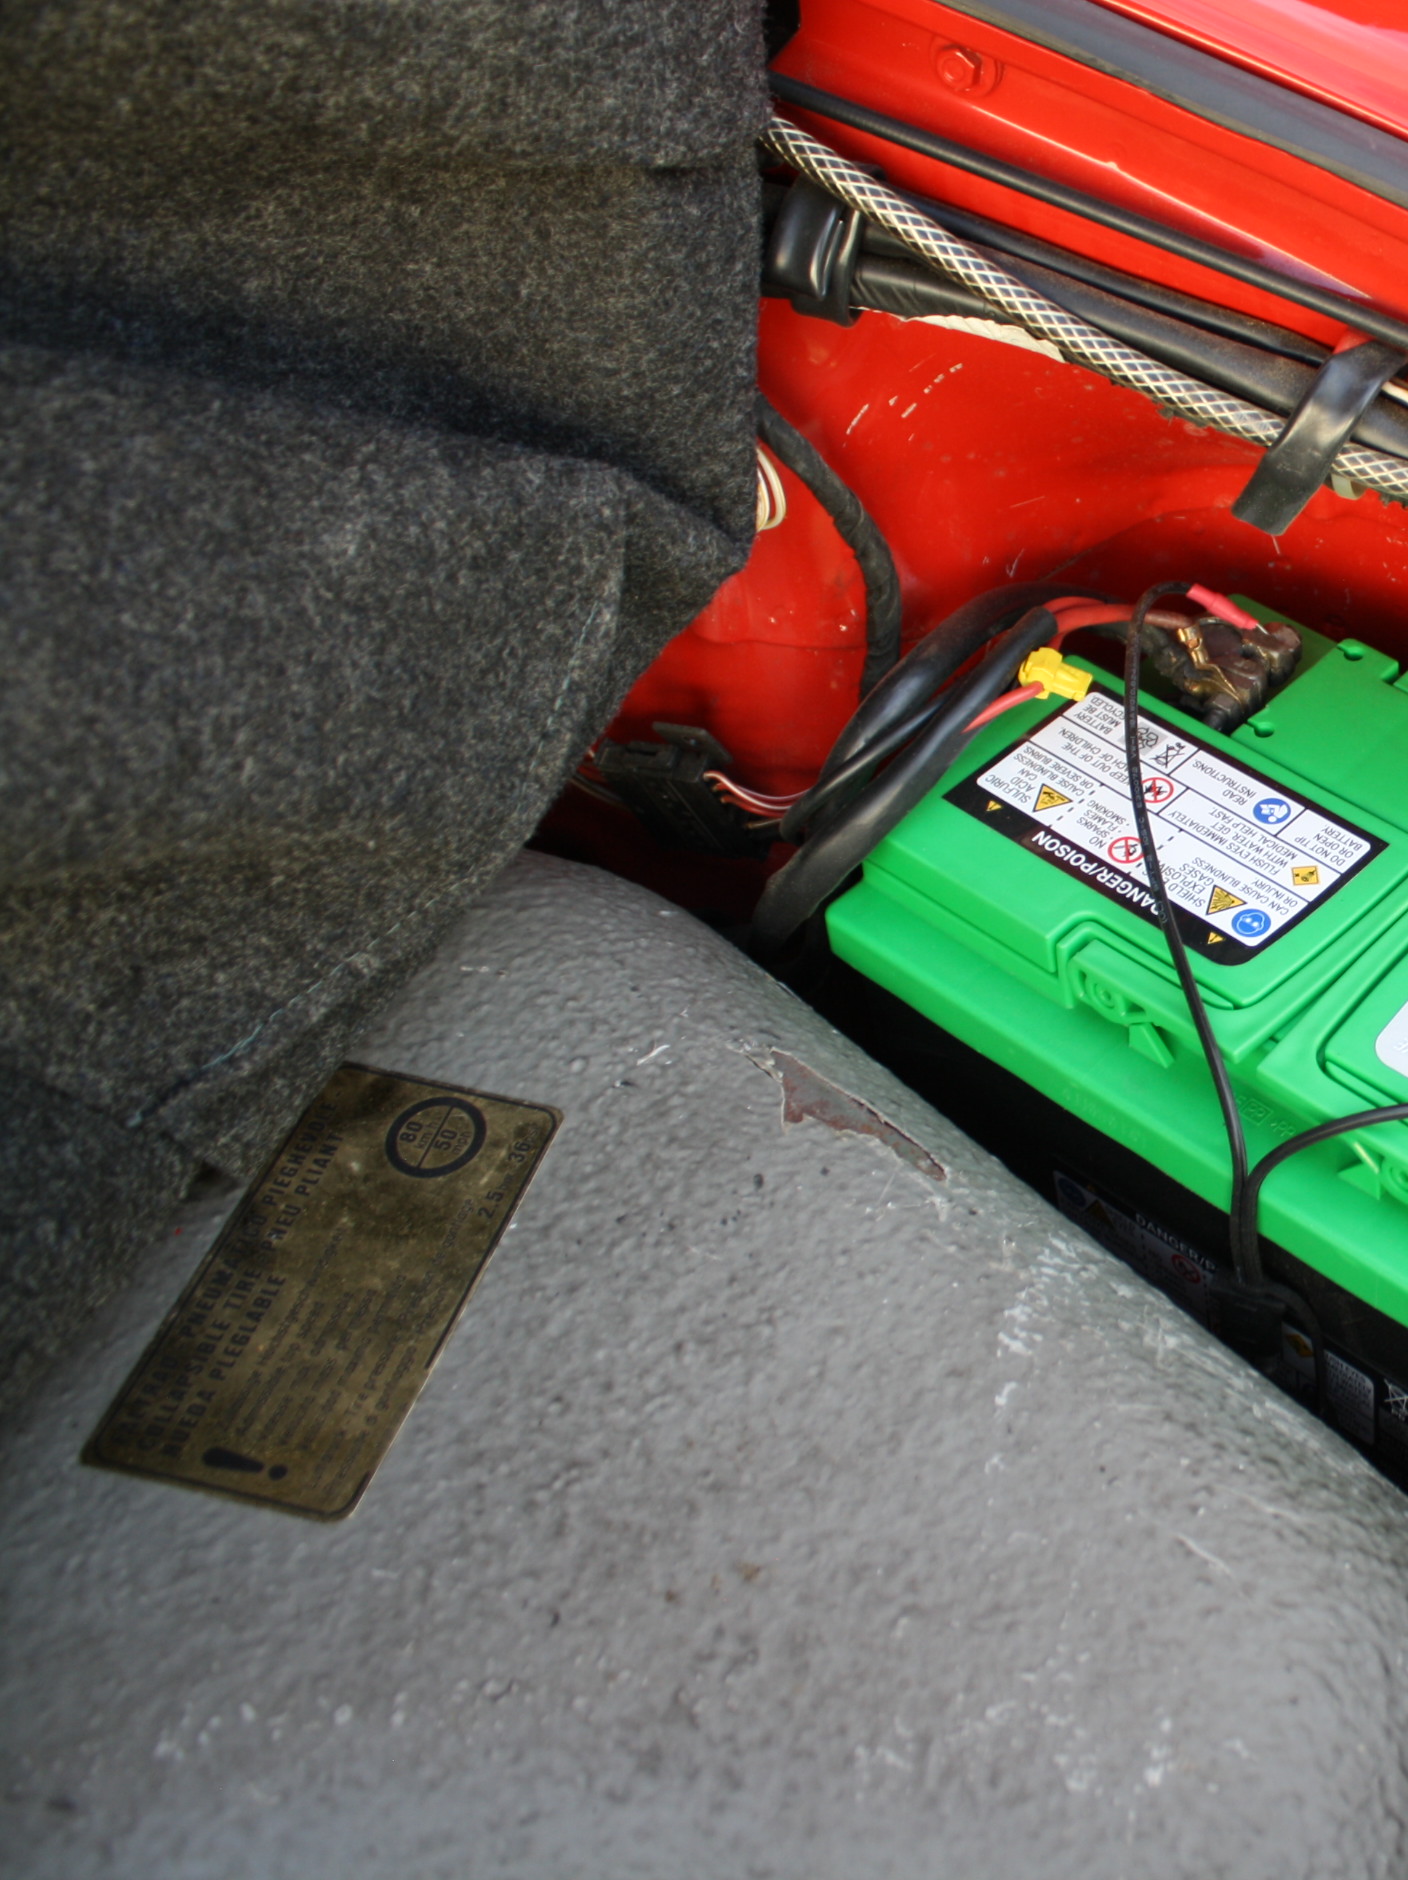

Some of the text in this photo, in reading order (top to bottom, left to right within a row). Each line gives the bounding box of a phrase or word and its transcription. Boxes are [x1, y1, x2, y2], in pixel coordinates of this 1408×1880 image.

[1071, 710, 1114, 735] BATTERY
[1081, 703, 1123, 727] MUST BE
[1056, 726, 1103, 756] CHILDREN.
[1021, 745, 1094, 789] OR SEVERE BURNS.
[1059, 741, 1135, 786] KEEP OUT OF THE
[1097, 750, 1115, 762] OF
[1008, 774, 1036, 793] ACID
[1012, 751, 1086, 797] CAUSE BLINDNESS
[1016, 766, 1039, 782] CAN
[1188, 758, 1258, 798] INSTRUCTIONS.
[983, 772, 1032, 805] SULFURIC
[1220, 788, 1249, 806] READ
[1082, 808, 1119, 832] FLAMES
[1085, 798, 1127, 826] SMOKING
[1075, 815, 1111, 839] SPARKS
[1206, 806, 1298, 860] MEDICAL HELP FAST.
[1317, 824, 1365, 851] BATTERY.
[1087, 834, 1107, 849] NO
[1167, 808, 1281, 875] FLUSH EYES IMMEDIATELY
[1209, 820, 1290, 867] WITH WATER. GET
[1292, 834, 1347, 866] DO NOT TIP
[1310, 832, 1356, 858] OR OPEN
[1029, 828, 1168, 915] DANGER/POISON
[1152, 860, 1206, 894] EXPLOSIV
[1177, 861, 1216, 887] GASES
[1190, 855, 1242, 887] BLINDNESS
[1165, 880, 1207, 908] SHIELD
[1237, 882, 1271, 905] CAUSE
[1249, 876, 1301, 908] OR INJURY.
[1266, 899, 1291, 916] CAN
[396, 1119, 425, 1145] 80
[430, 1127, 459, 1153] 50
[448, 1128, 474, 1156] mph
[259, 1100, 338, 1206] PIEGHEVOLE
[474, 1139, 532, 1220] 2.5 36
[1135, 1212, 1217, 1272] DANGER/P
[132, 1131, 347, 1452] COLLAPSIBLE TIRE PNEU PLIANT
